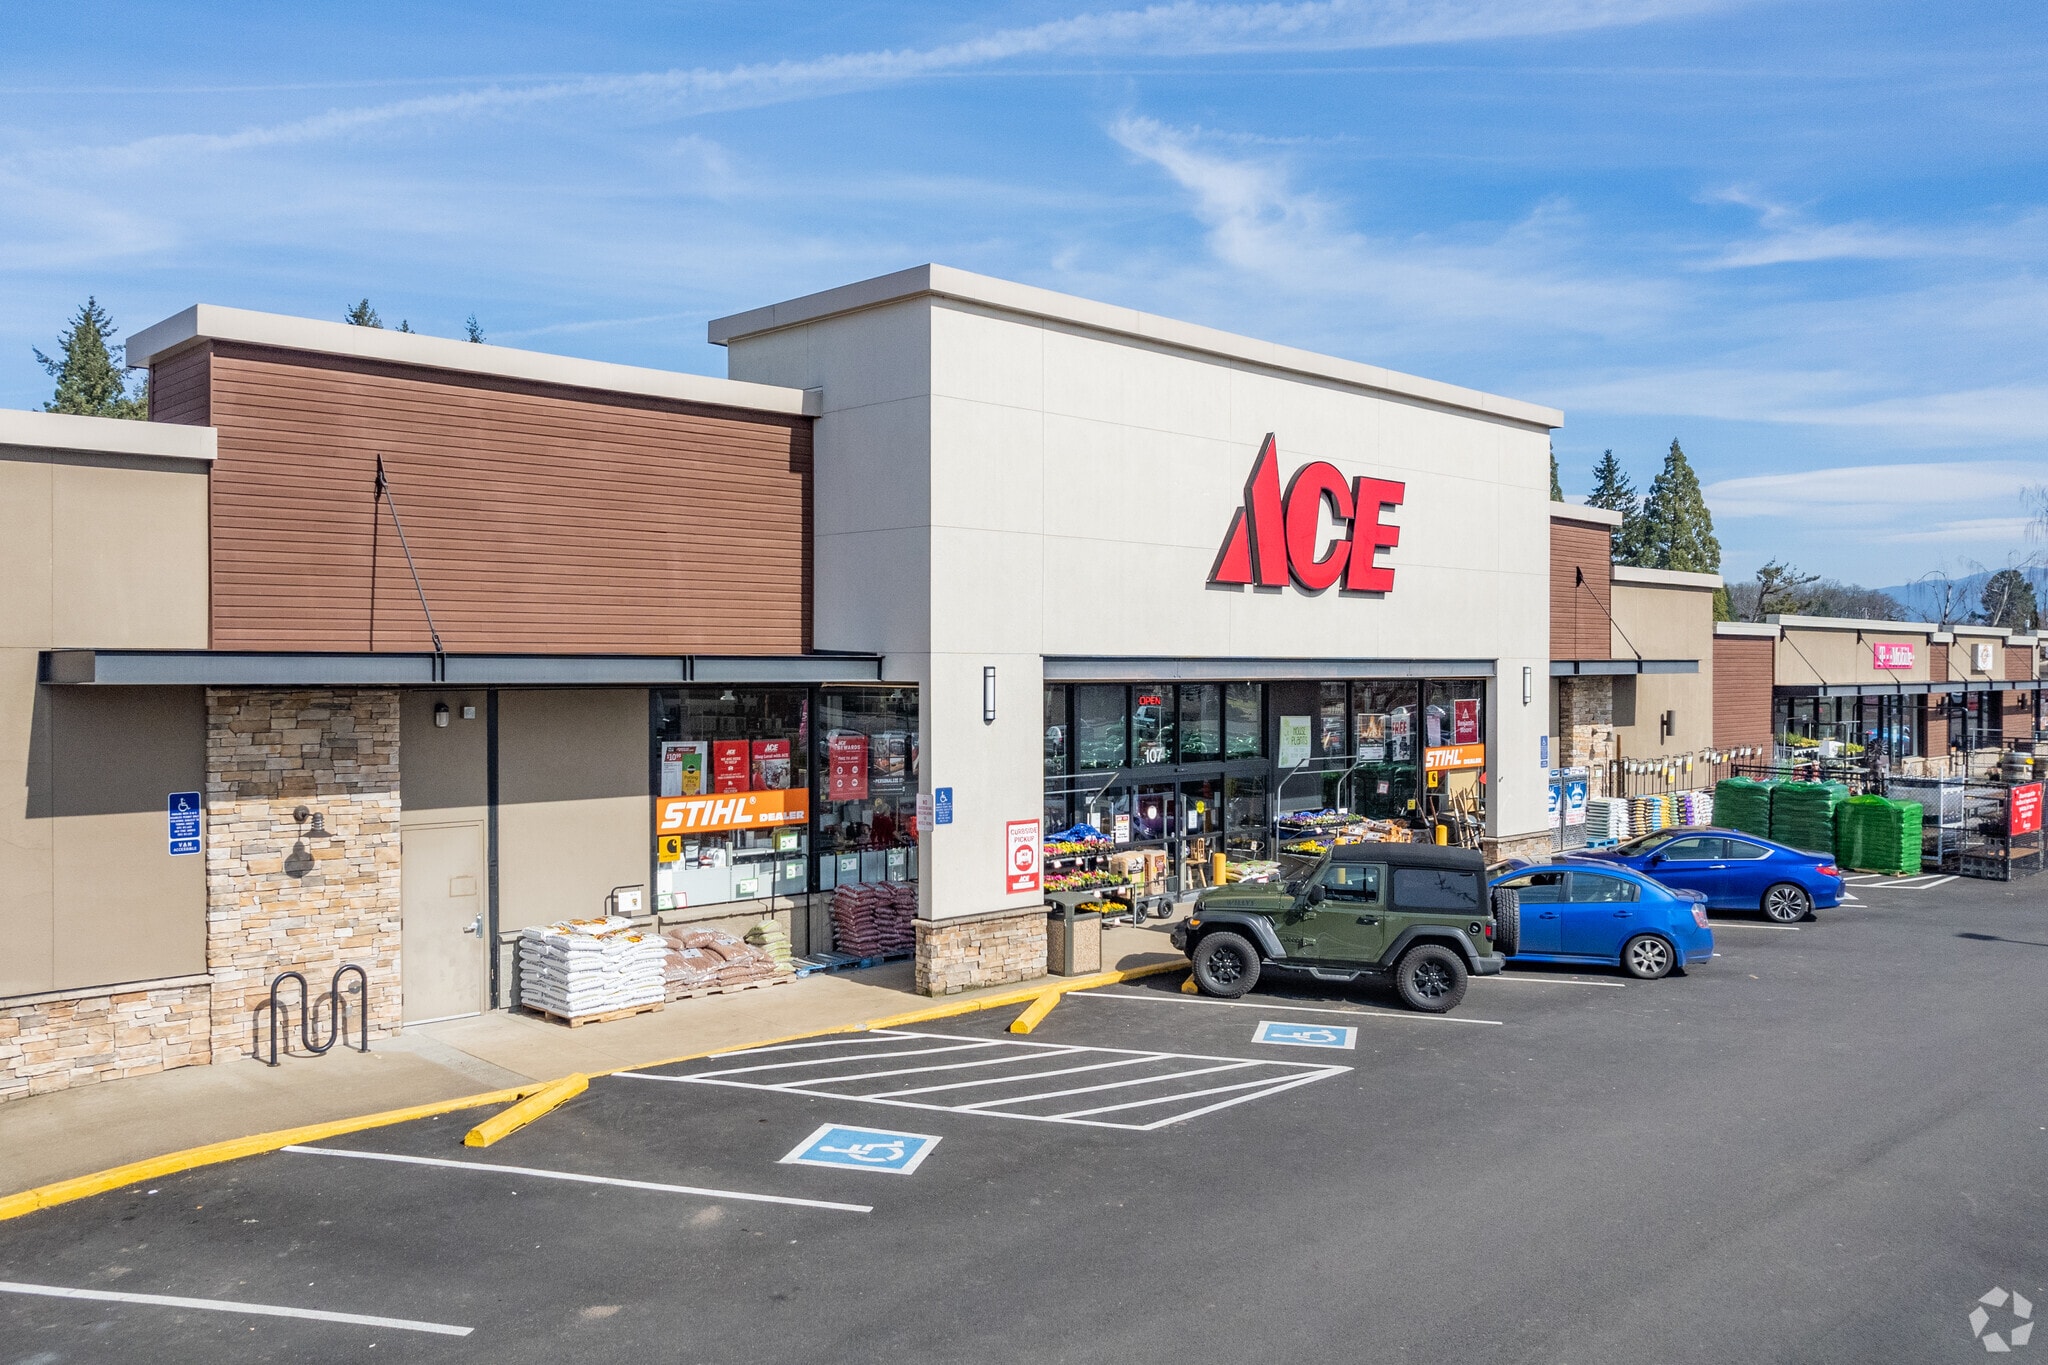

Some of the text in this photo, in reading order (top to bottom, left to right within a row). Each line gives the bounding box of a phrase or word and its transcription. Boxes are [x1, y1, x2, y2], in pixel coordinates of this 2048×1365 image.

[1206, 432, 1405, 593] ACE
[1139, 696, 1160, 704] OPEN
[1392, 722, 1407, 735] FREE
[765, 743, 778, 752] ACE
[1144, 748, 1162, 763] 107
[1425, 749, 1462, 767] STIHL
[661, 798, 804, 829] STIHL DEALER
[1010, 827, 1037, 835] CURBSIDE
[1014, 835, 1034, 843] PICKUP
